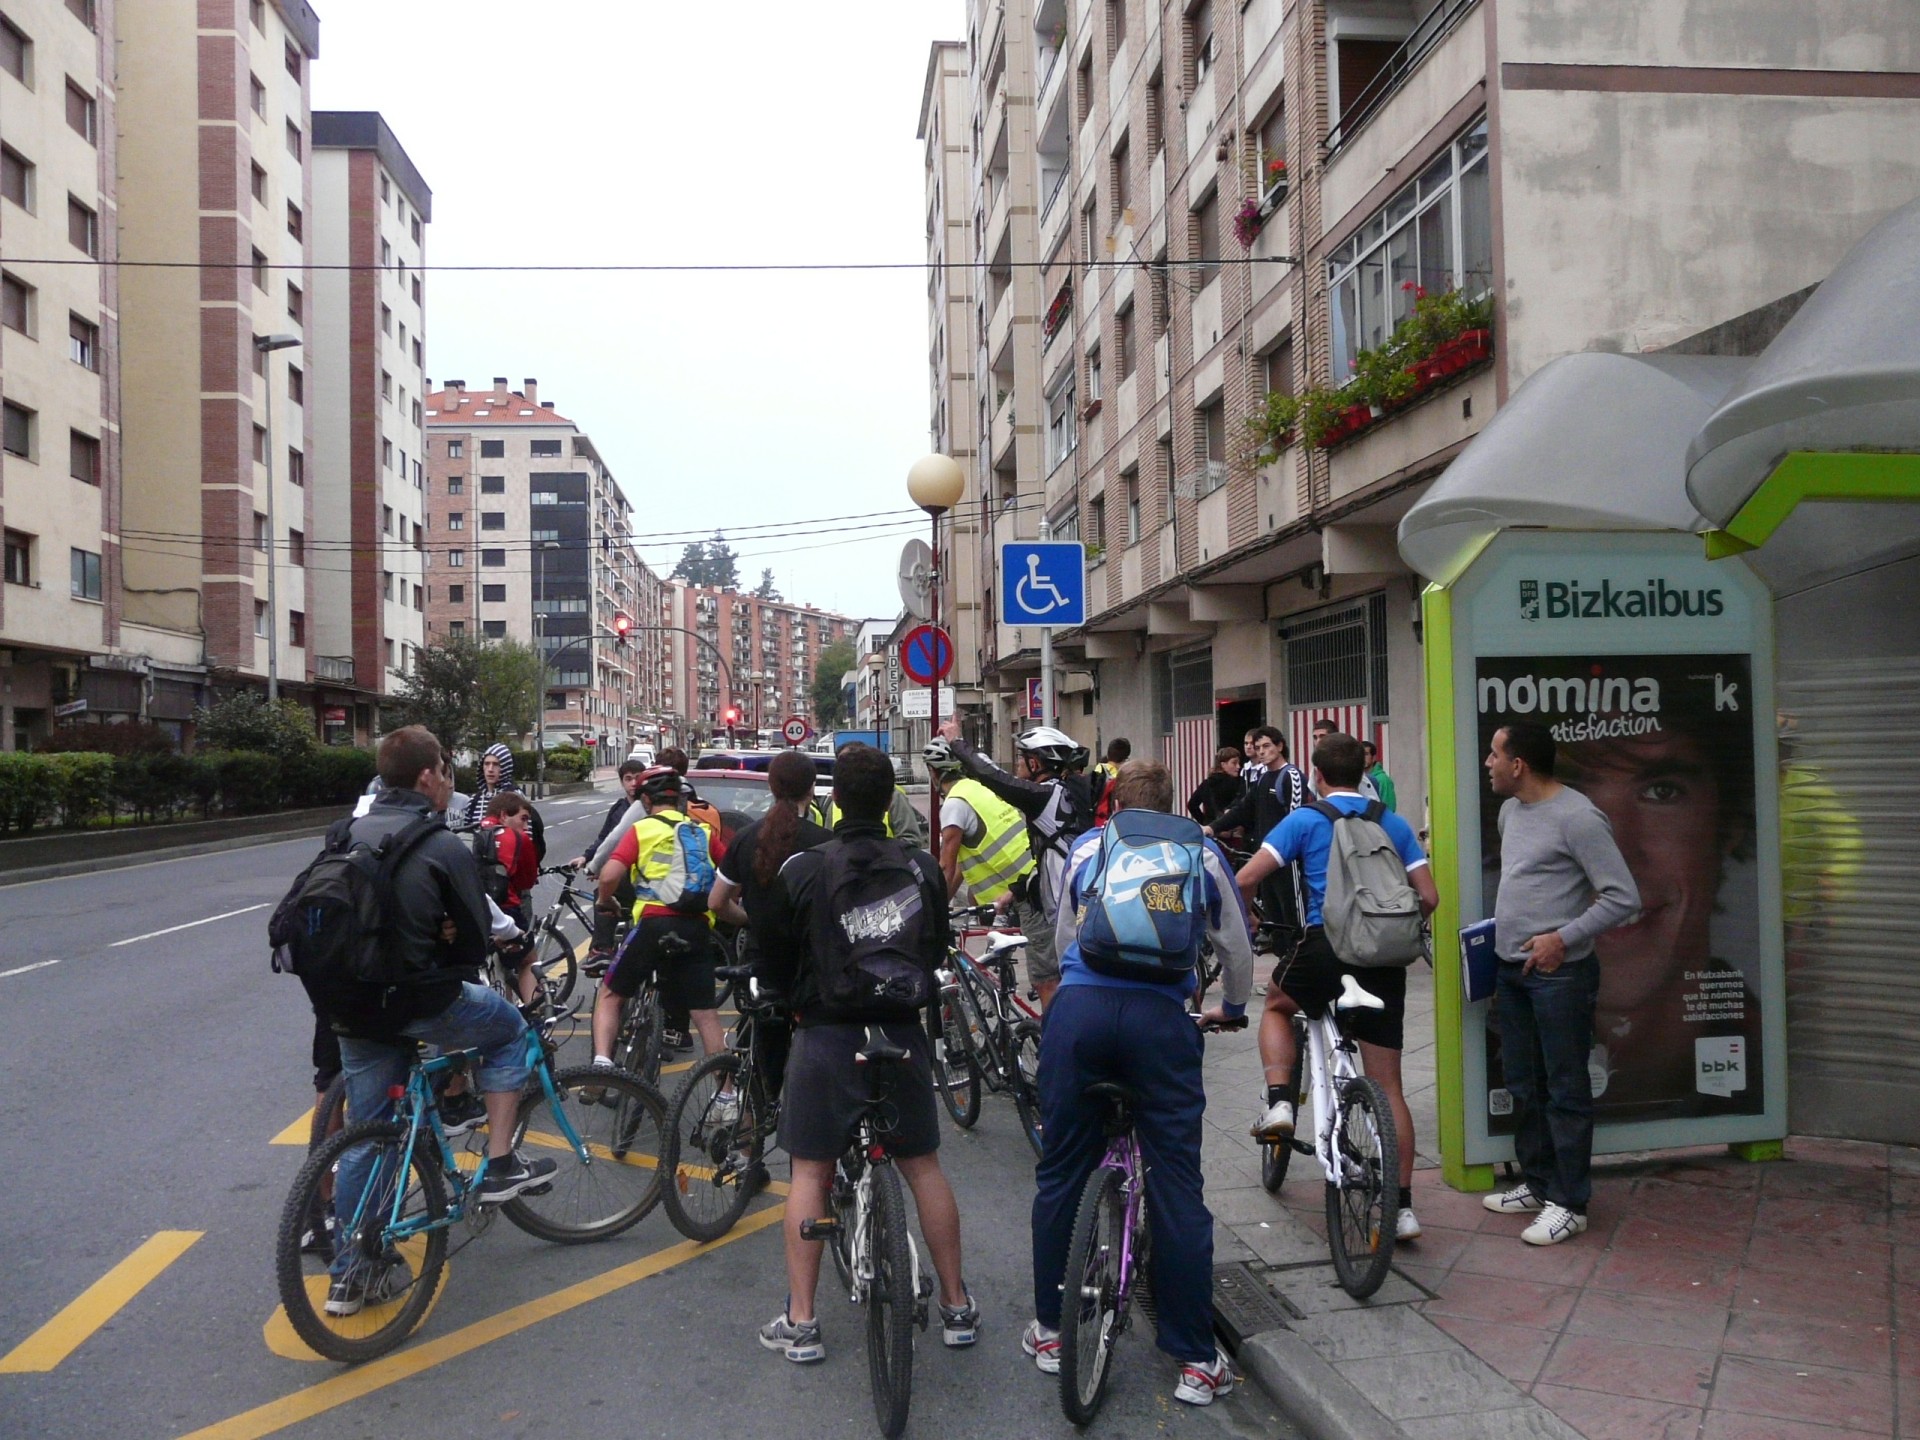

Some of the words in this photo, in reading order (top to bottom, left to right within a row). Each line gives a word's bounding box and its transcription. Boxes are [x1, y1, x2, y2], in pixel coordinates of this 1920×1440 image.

[1521, 582, 1537, 590] BFA
[1546, 578, 1724, 618] Bizkaibus
[890, 645, 899, 704] IDESA
[787, 726, 803, 735] 40
[1550, 712, 1662, 742] atisfaction
[1685, 971, 1695, 980] En
[1697, 970, 1743, 979] Kutxabank
[1699, 981, 1743, 991] queremos
[1683, 994, 1698, 1002] que
[1700, 992, 1709, 1000] tu
[1709, 1001, 1743, 1010] muchas
[1683, 1012, 1744, 1021] satisfacciones
[1702, 1060, 1739, 1073] bbk
